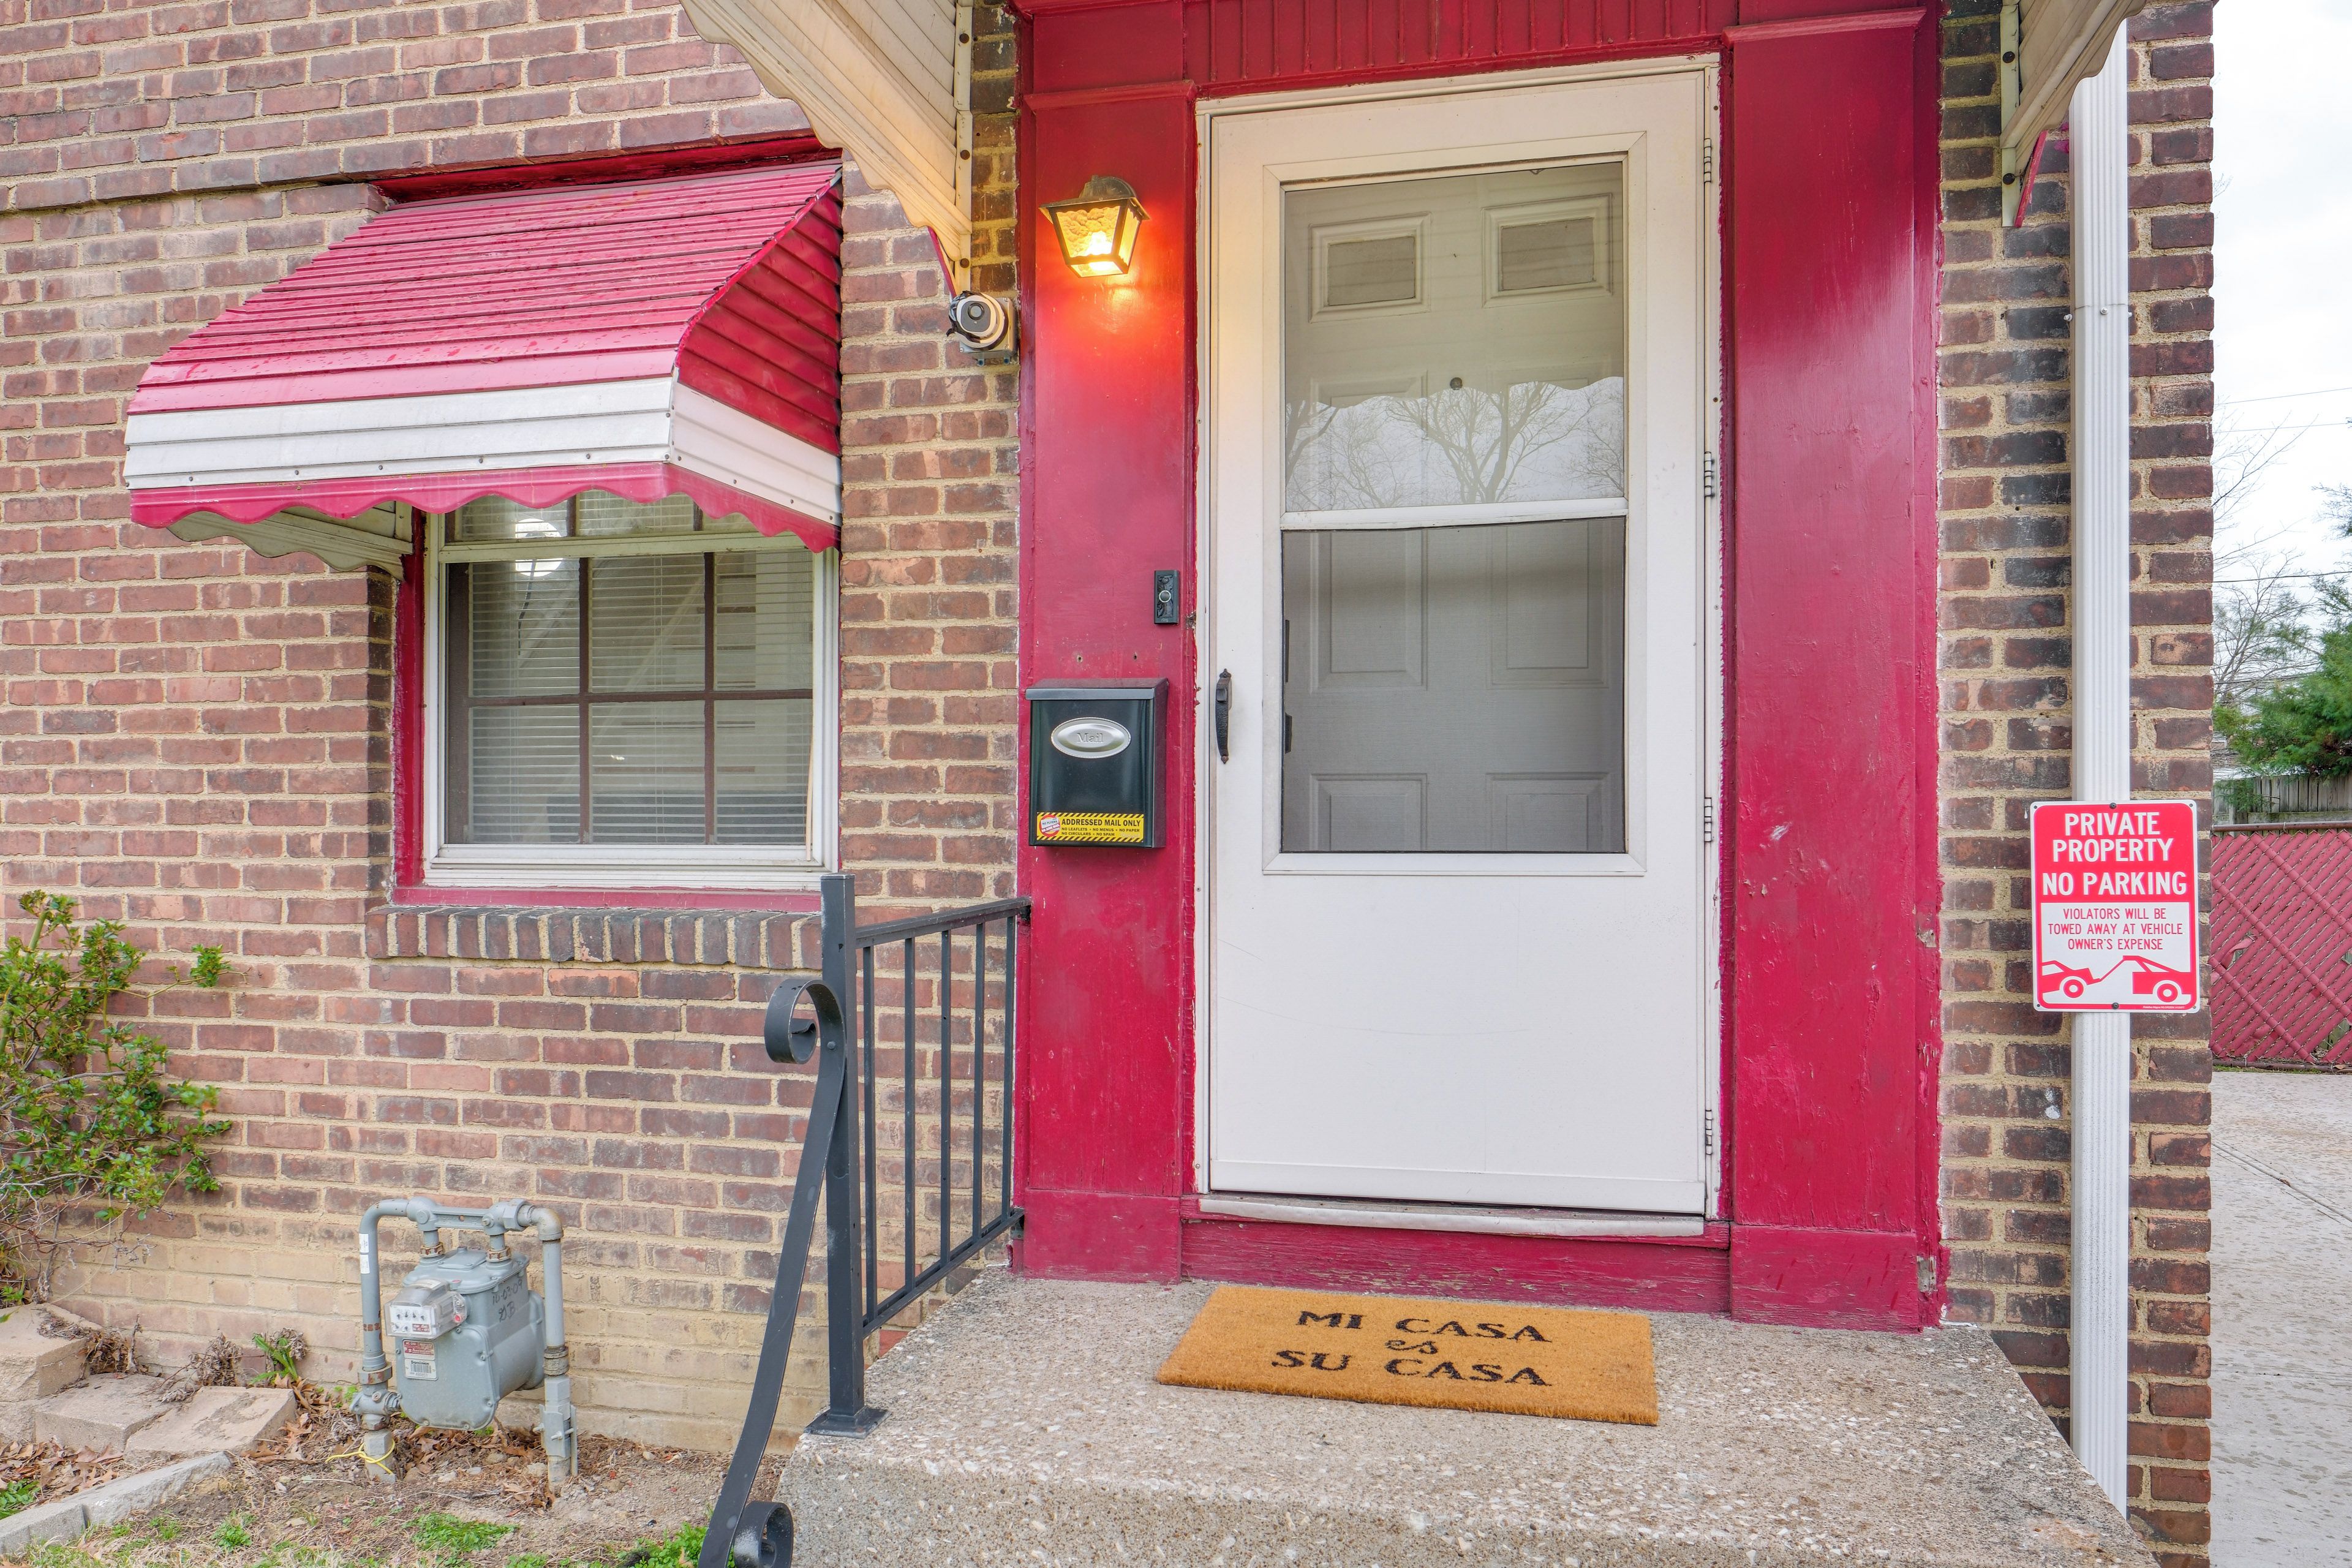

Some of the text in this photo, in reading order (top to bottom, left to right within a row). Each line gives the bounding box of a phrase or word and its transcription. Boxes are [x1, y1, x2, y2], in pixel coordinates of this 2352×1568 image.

[1076, 733, 1103, 743] Mail
[2065, 812, 2160, 836] PRIVATE
[2052, 838, 2173, 862] PROPERTY
[2043, 871, 2187, 895] NO PARKING
[2063, 908, 2166, 919] VIOLATORS WILL BE
[2048, 923, 2183, 935] TOWED AWAY AT VEHICLE
[2068, 938, 2163, 950] OWNER'S EXPENSE
[1295, 1310, 1553, 1343] MI CASA
[1384, 1339, 1439, 1355] es
[1271, 1349, 1553, 1387] SU CASA
